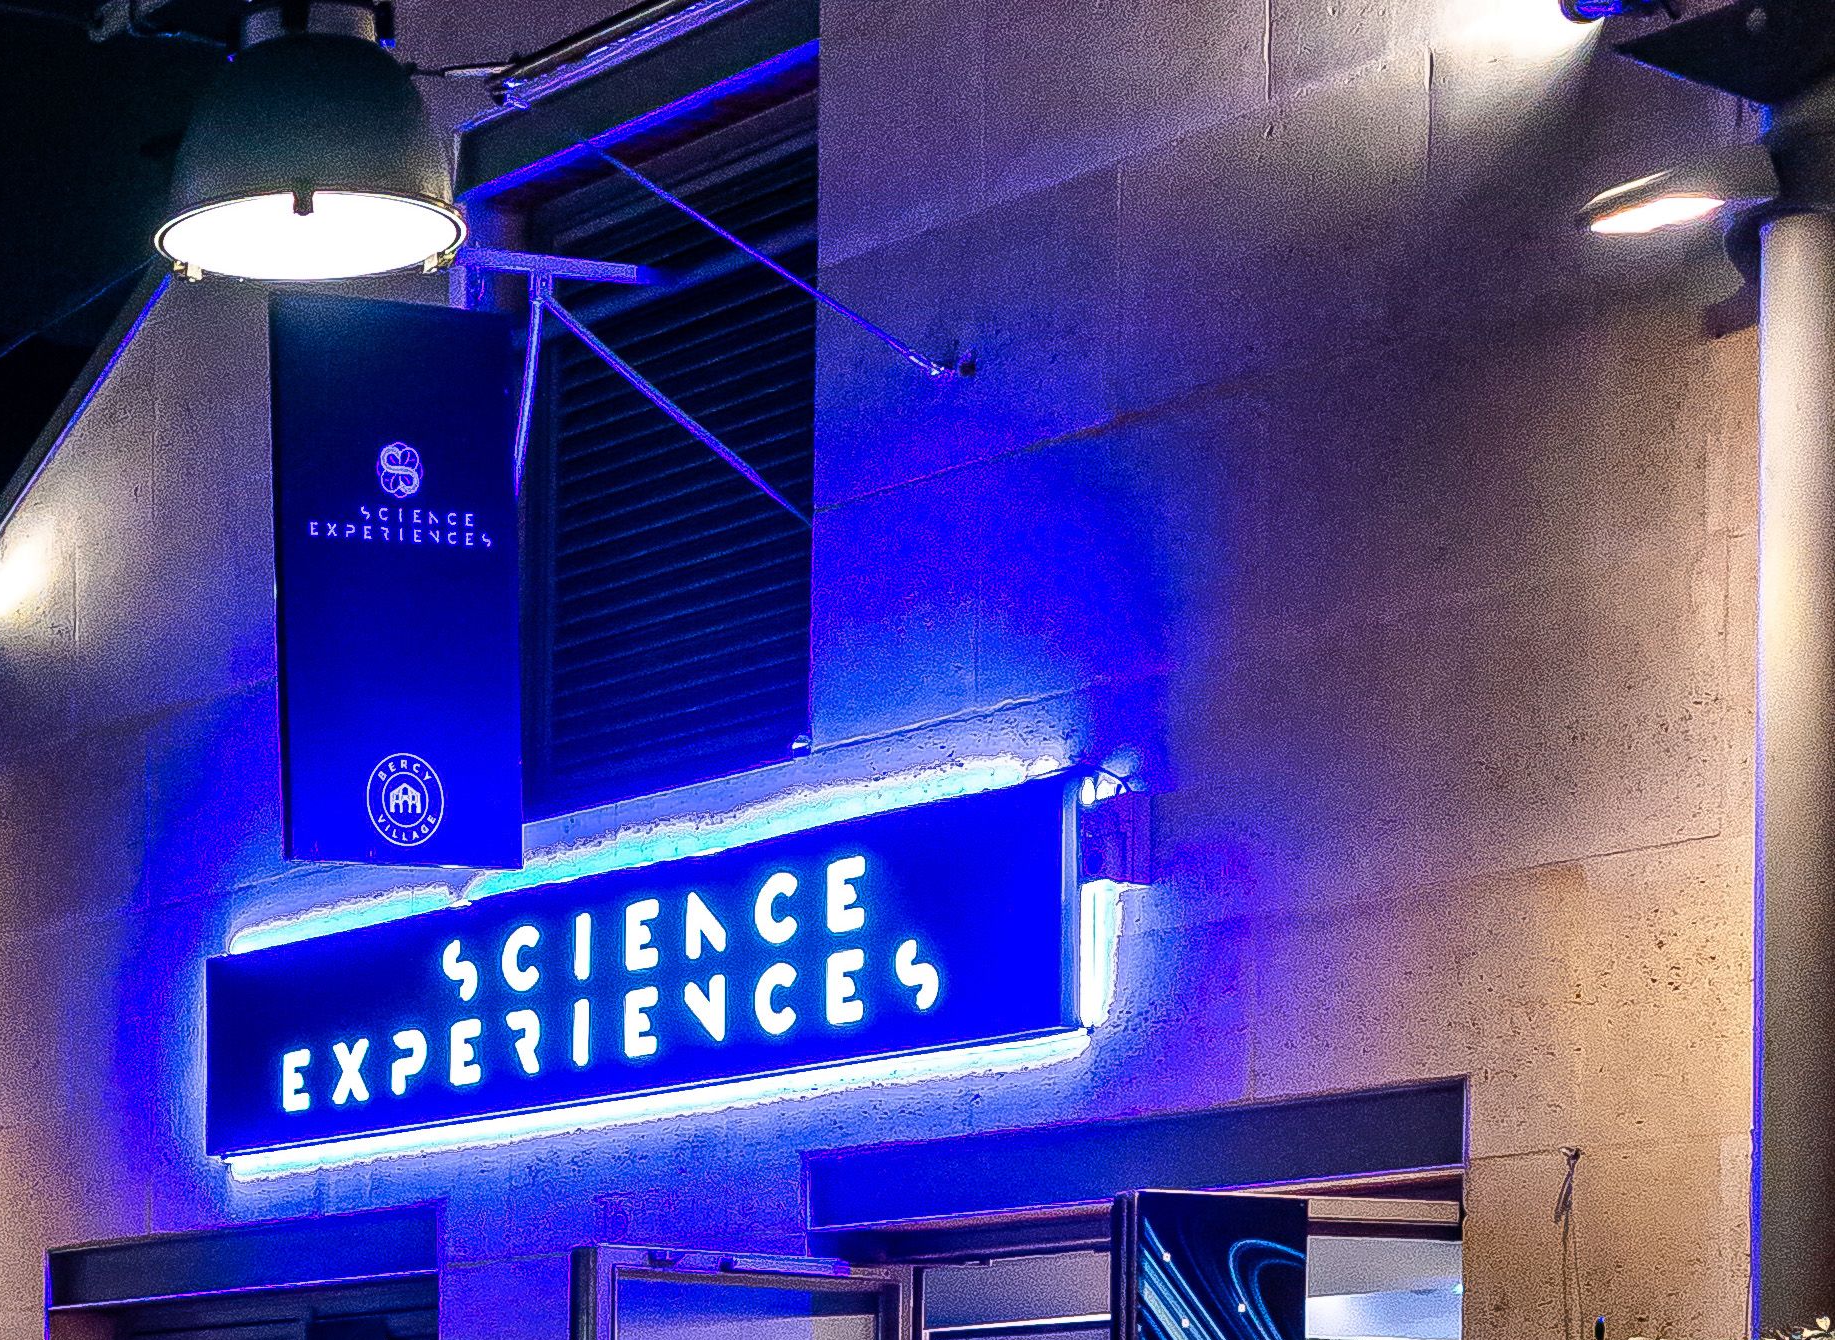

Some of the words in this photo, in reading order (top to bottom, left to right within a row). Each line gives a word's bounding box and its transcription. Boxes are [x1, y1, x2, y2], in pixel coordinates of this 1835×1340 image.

[360, 505, 475, 528] SCIENCE
[309, 521, 492, 547] EXPERIENCES
[377, 759, 433, 782] BERCY
[377, 813, 437, 842] VILLAGE
[442, 853, 867, 1003] SCIENCE
[281, 937, 940, 1114] EXPERIENCES
